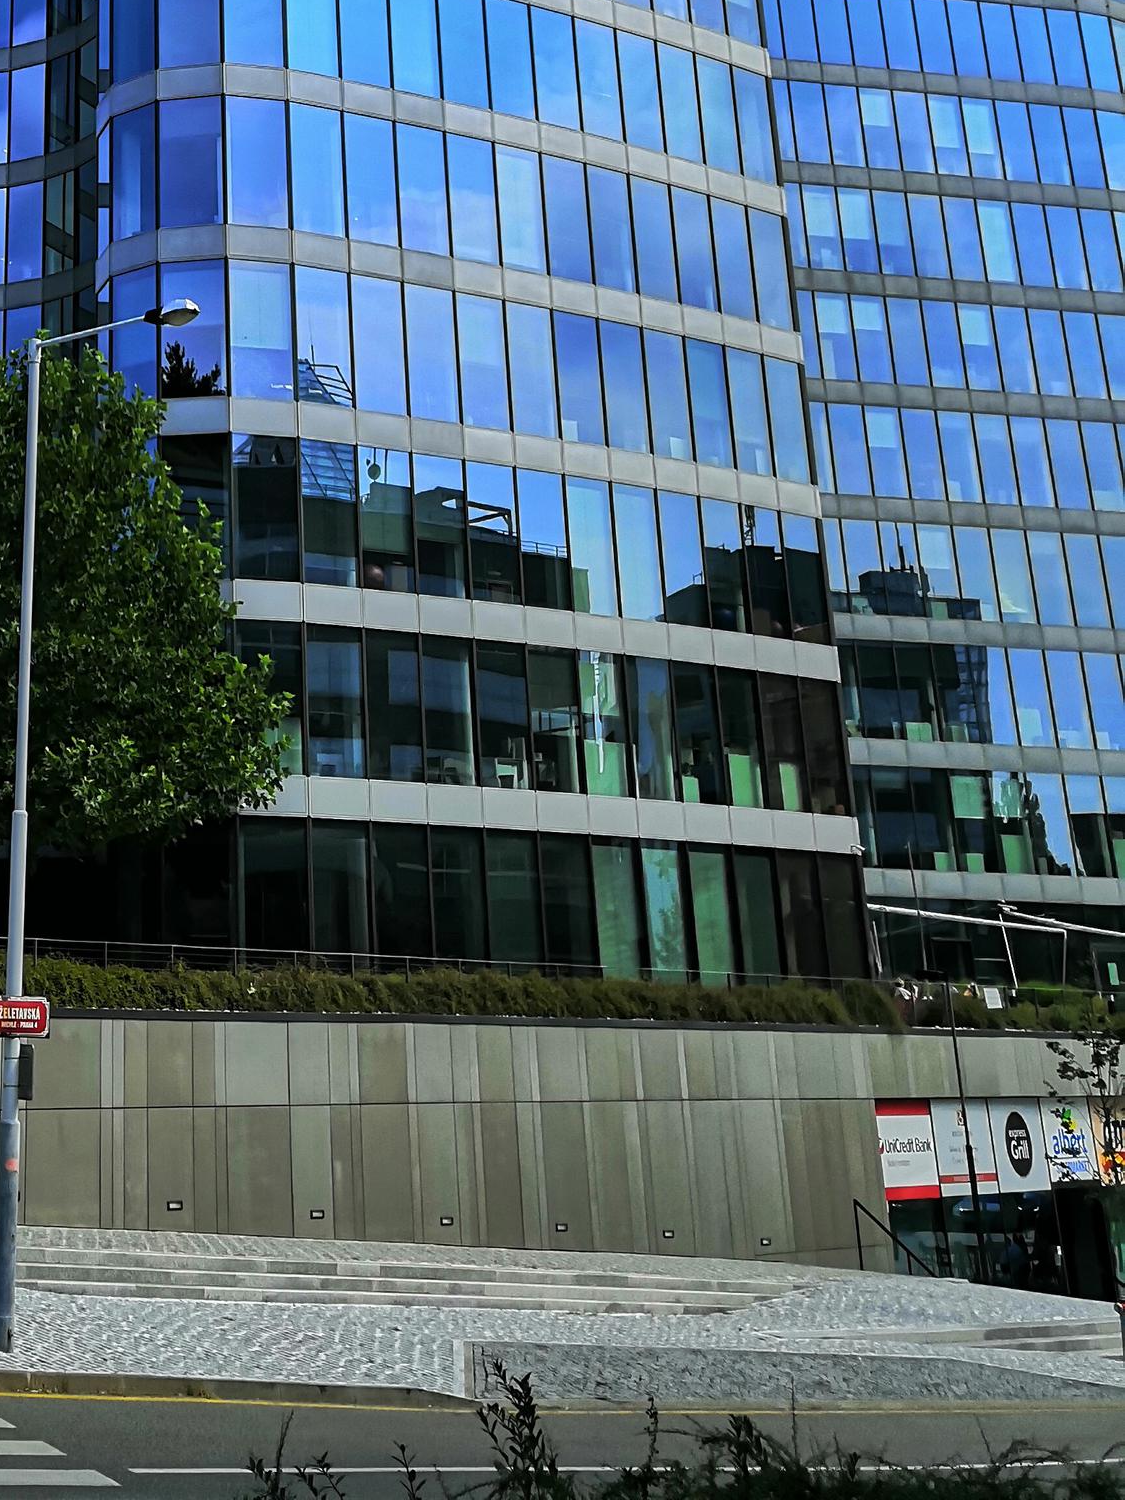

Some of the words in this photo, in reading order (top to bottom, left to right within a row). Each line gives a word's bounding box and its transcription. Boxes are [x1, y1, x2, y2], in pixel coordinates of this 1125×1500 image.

[884, 1137, 915, 1154] UniCredit
[915, 1137, 933, 1153] Bank
[1010, 1140, 1029, 1160] Grill
